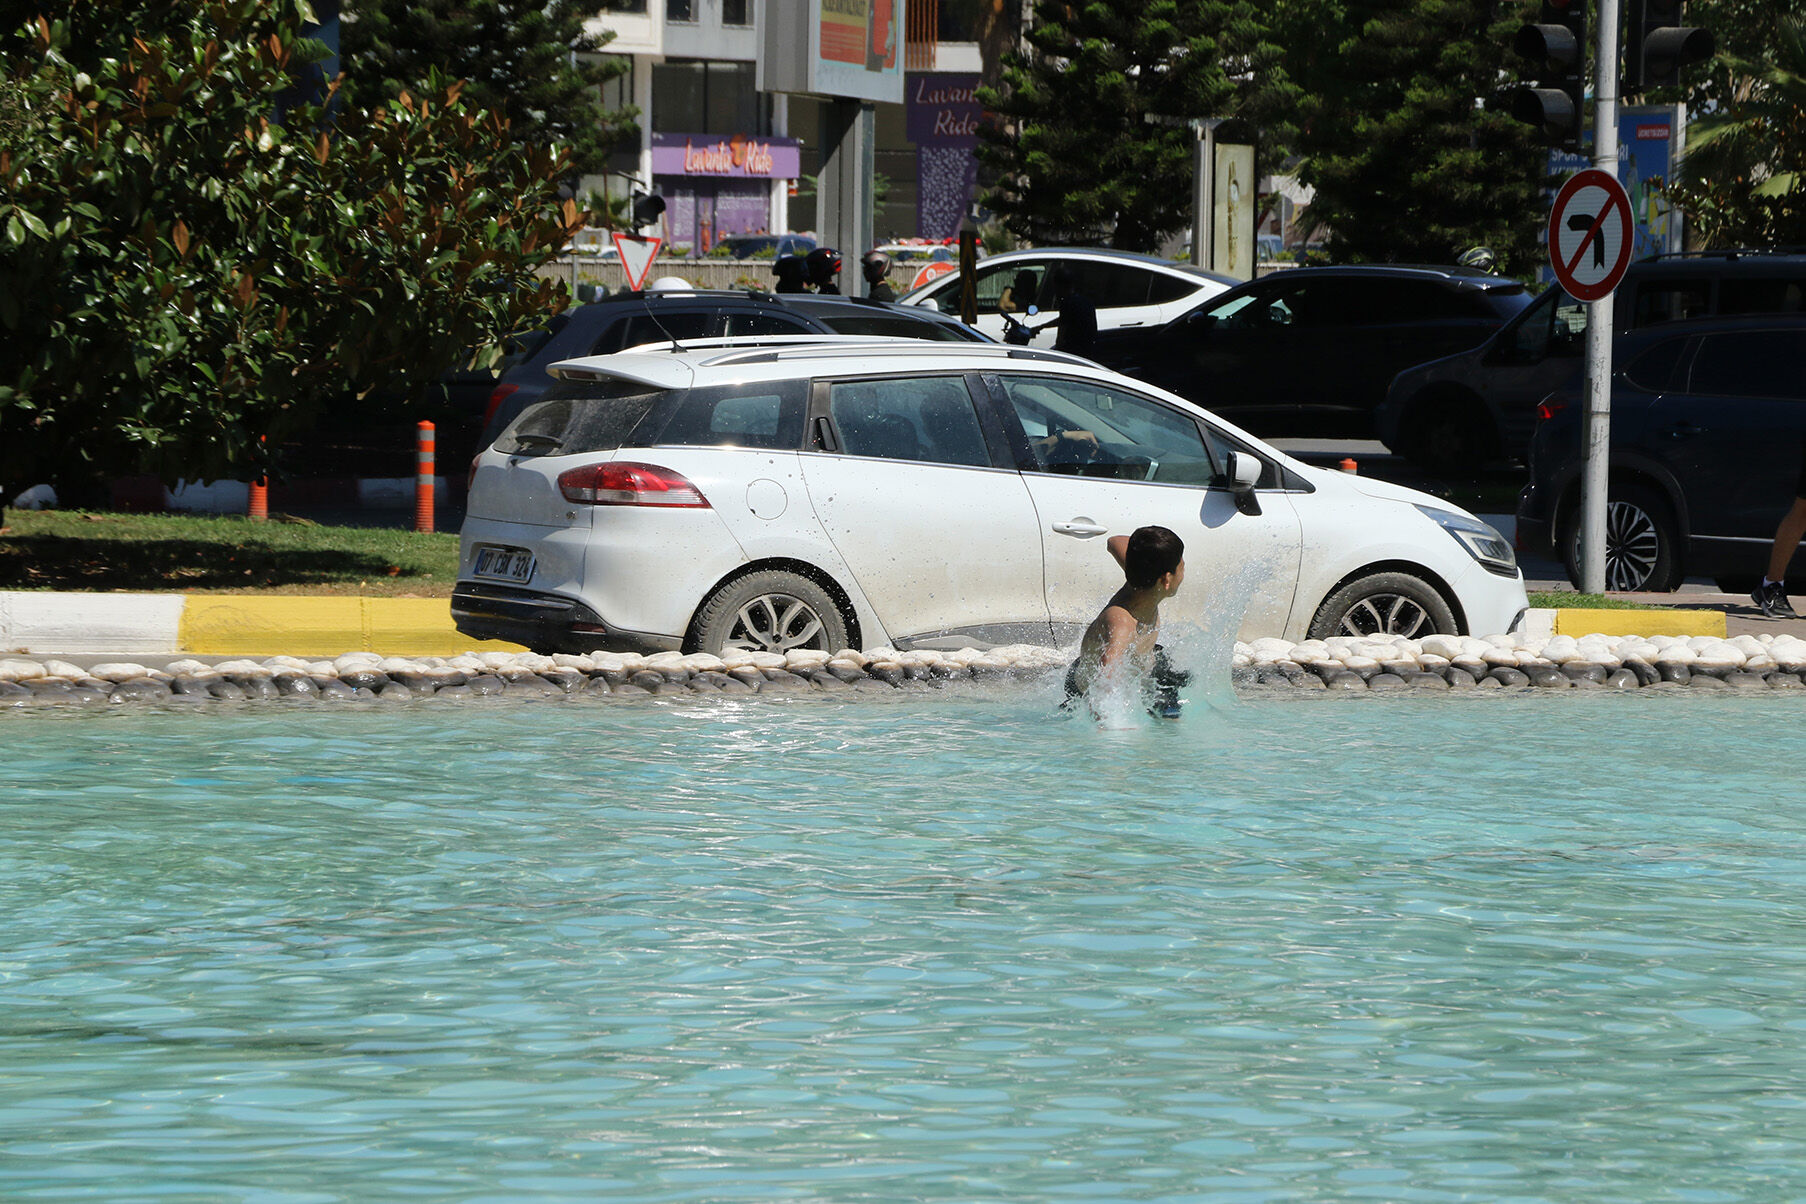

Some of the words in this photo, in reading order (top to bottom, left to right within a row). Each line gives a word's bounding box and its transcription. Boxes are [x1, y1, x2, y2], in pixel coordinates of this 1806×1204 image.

[934, 109, 979, 135] Ride
[684, 137, 731, 173] Lavanta
[744, 139, 773, 174] Ride
[480, 551, 495, 572] 07
